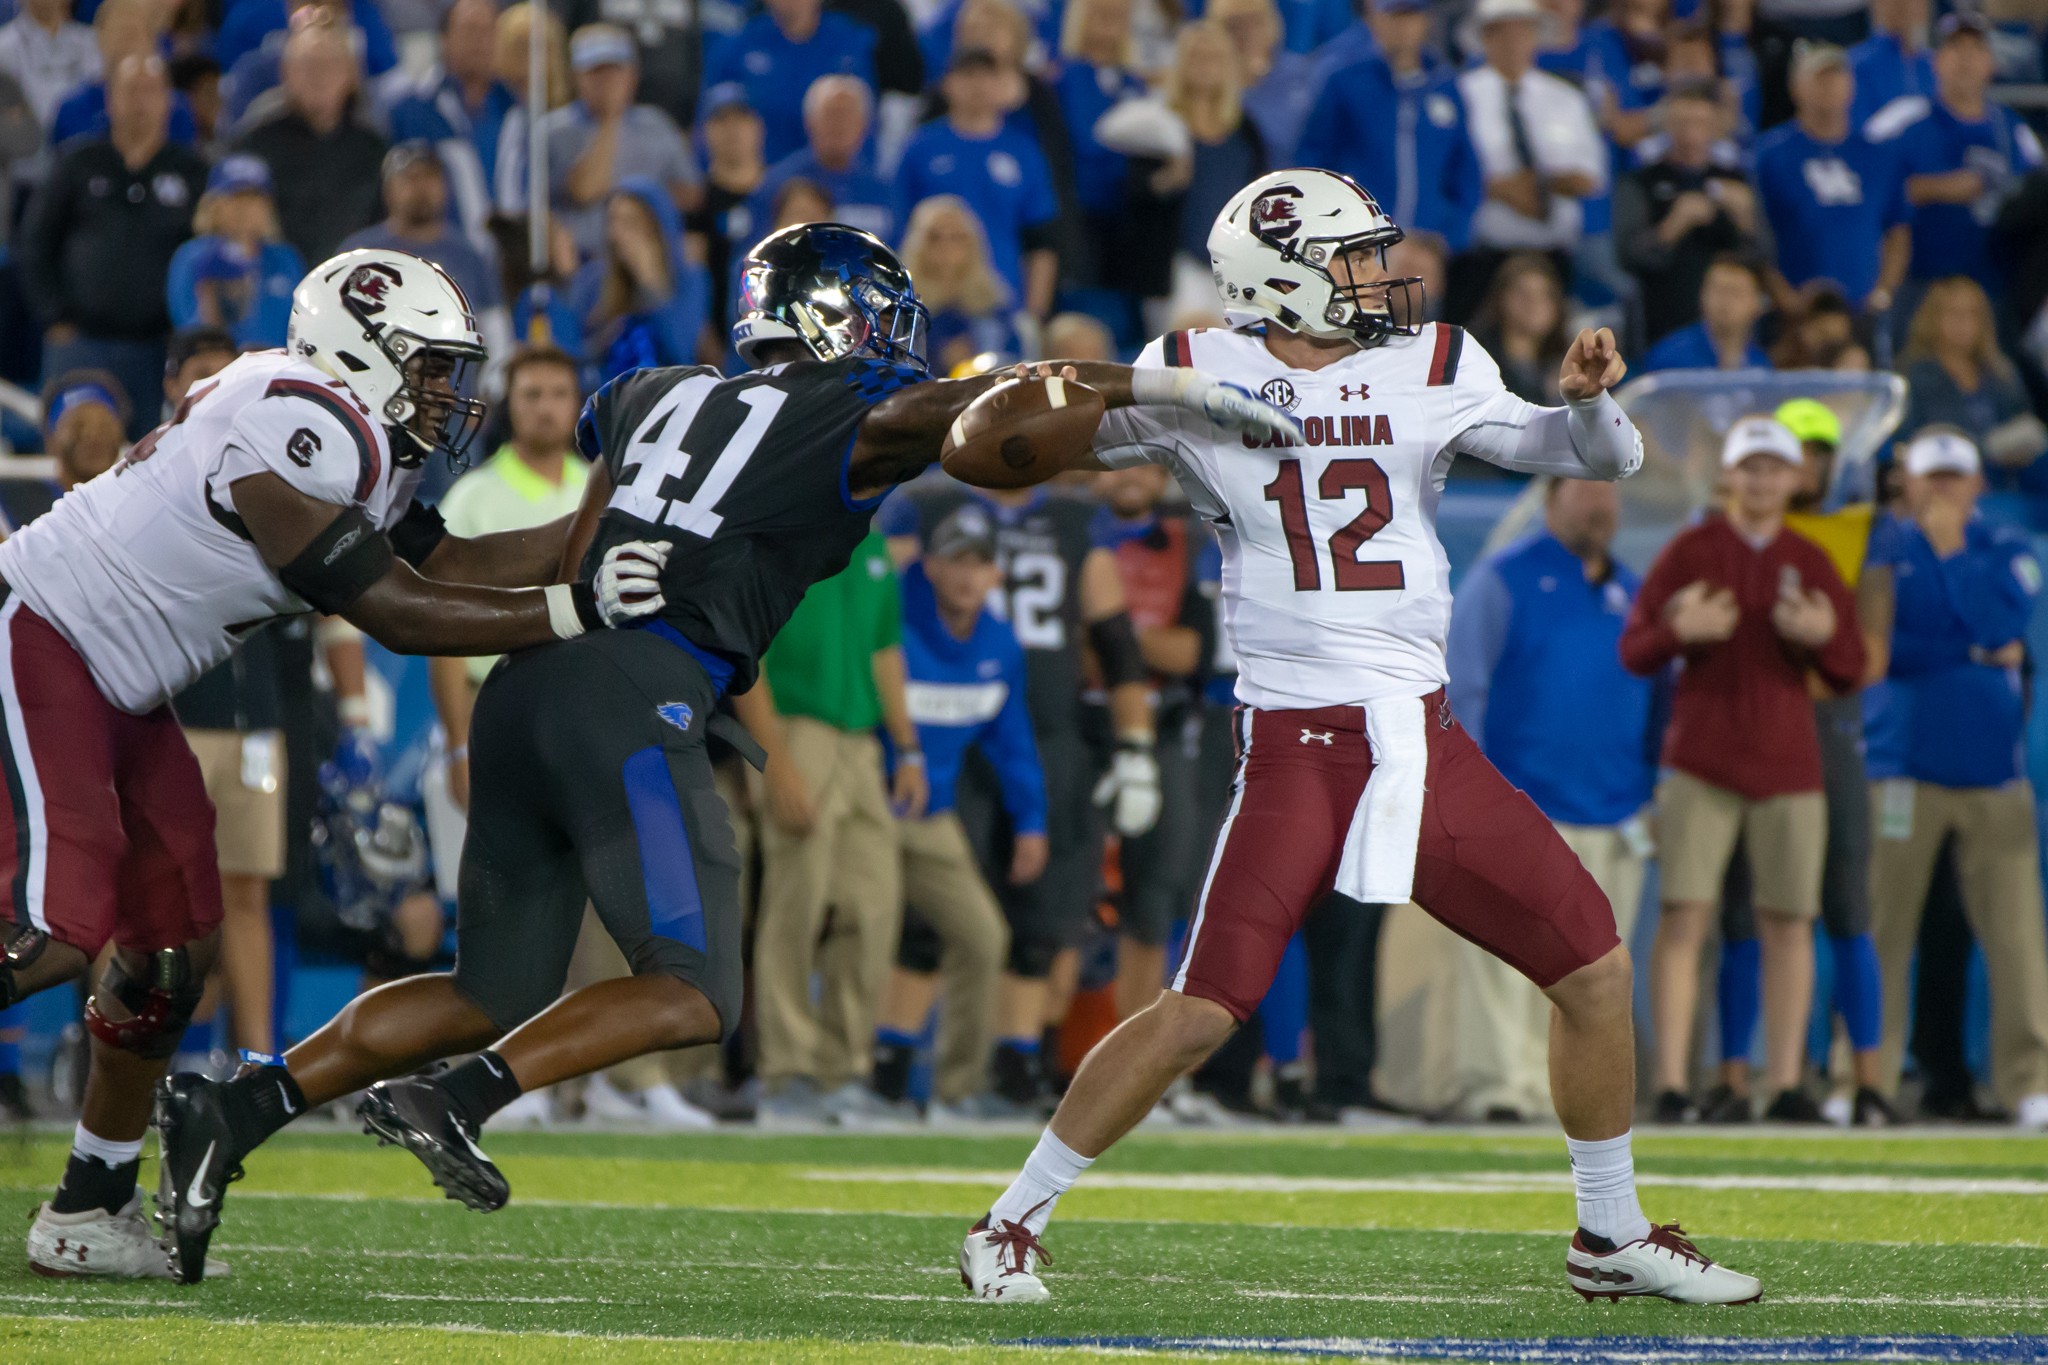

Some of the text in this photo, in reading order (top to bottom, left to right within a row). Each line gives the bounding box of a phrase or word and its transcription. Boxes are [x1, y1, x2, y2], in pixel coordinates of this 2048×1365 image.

[607, 373, 789, 539] 41
[1263, 380, 1292, 406] SEC
[1263, 458, 1405, 592] 12
